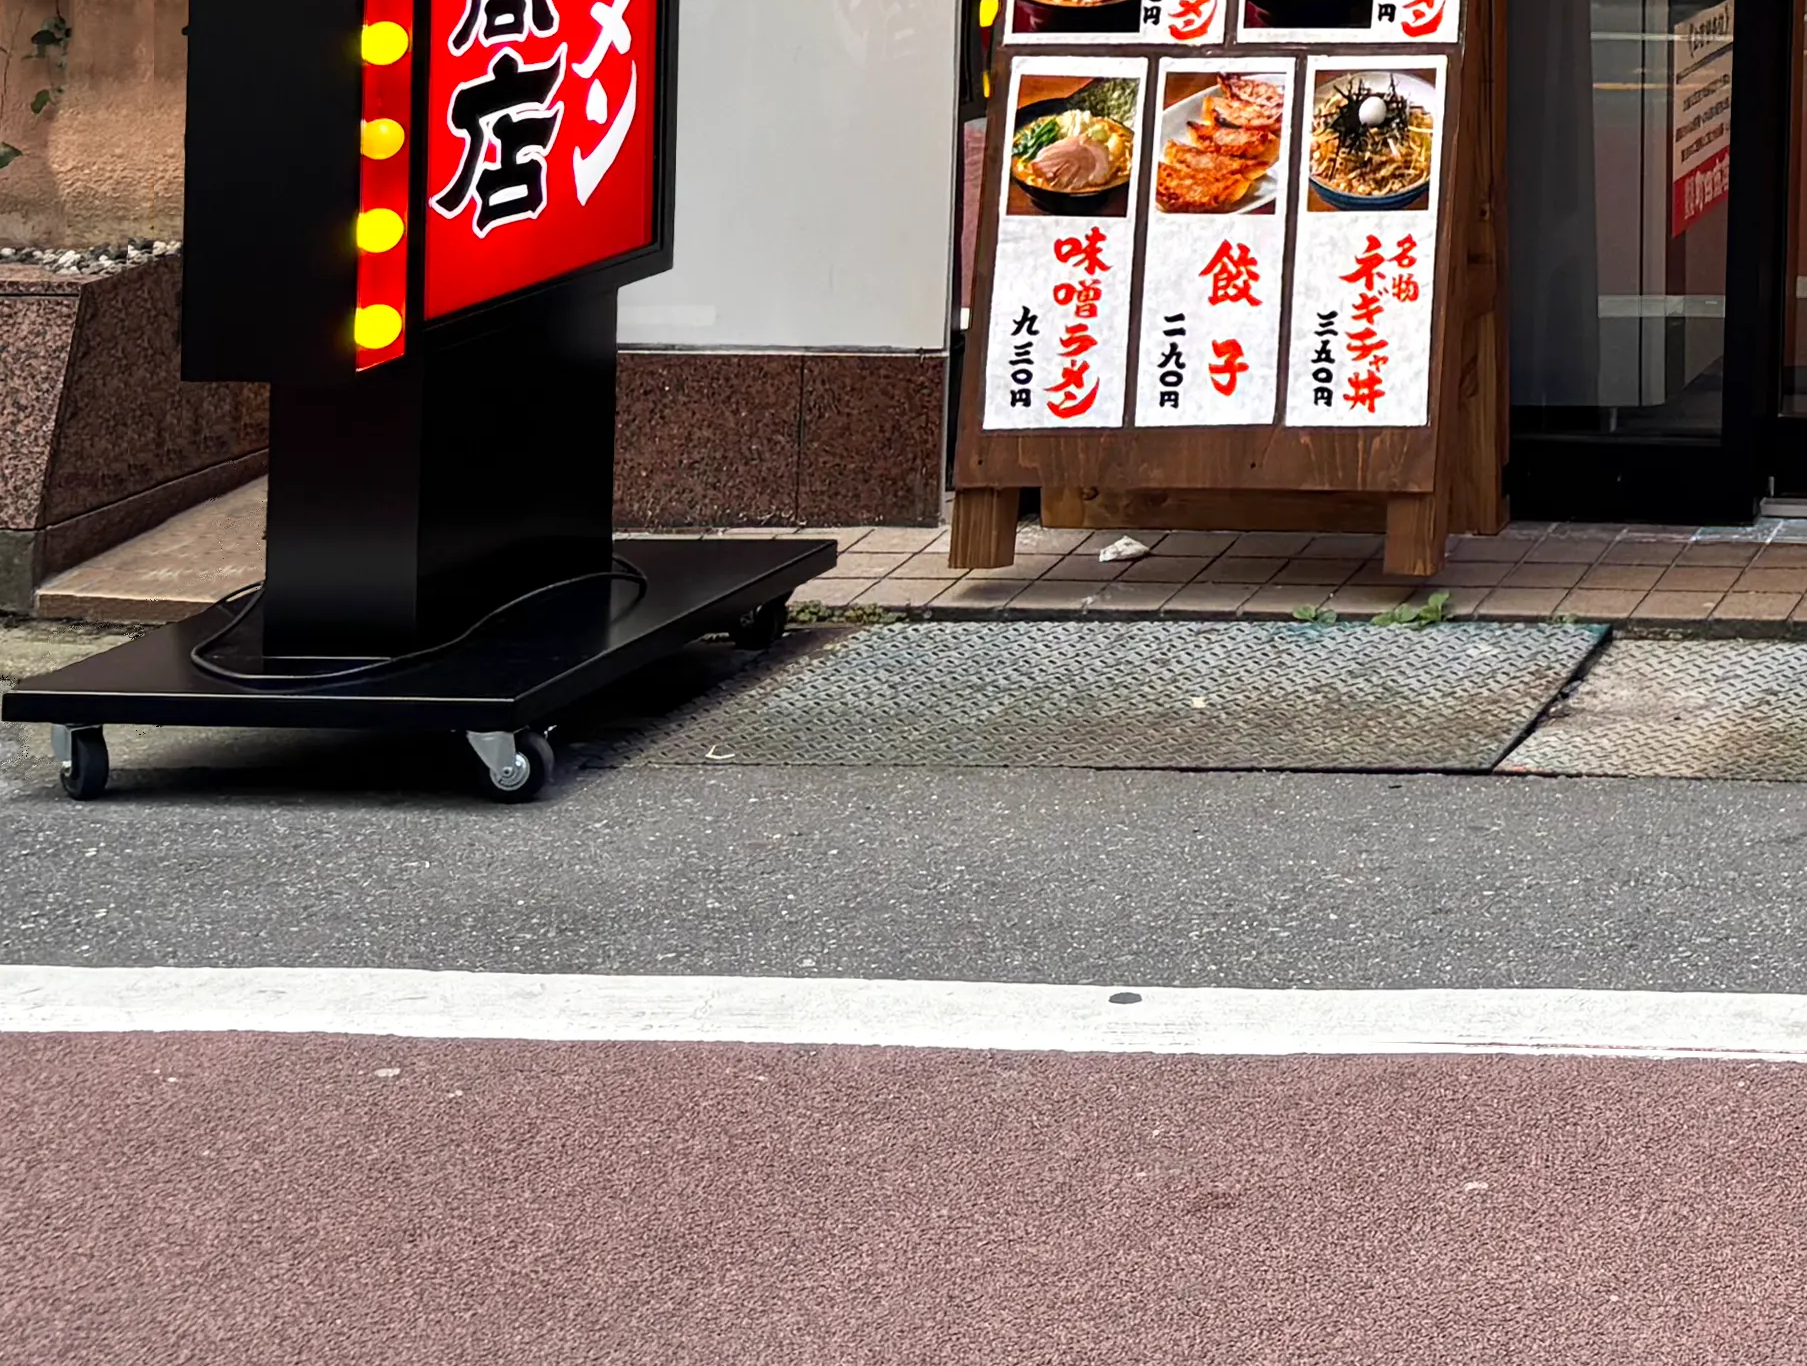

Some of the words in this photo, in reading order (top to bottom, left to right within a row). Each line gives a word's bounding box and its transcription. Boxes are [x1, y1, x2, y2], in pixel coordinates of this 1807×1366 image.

[1043, 226, 1114, 419] 味噌ラーメン
[1198, 239, 1263, 397] 餃子
[1388, 233, 1420, 304] 名物
